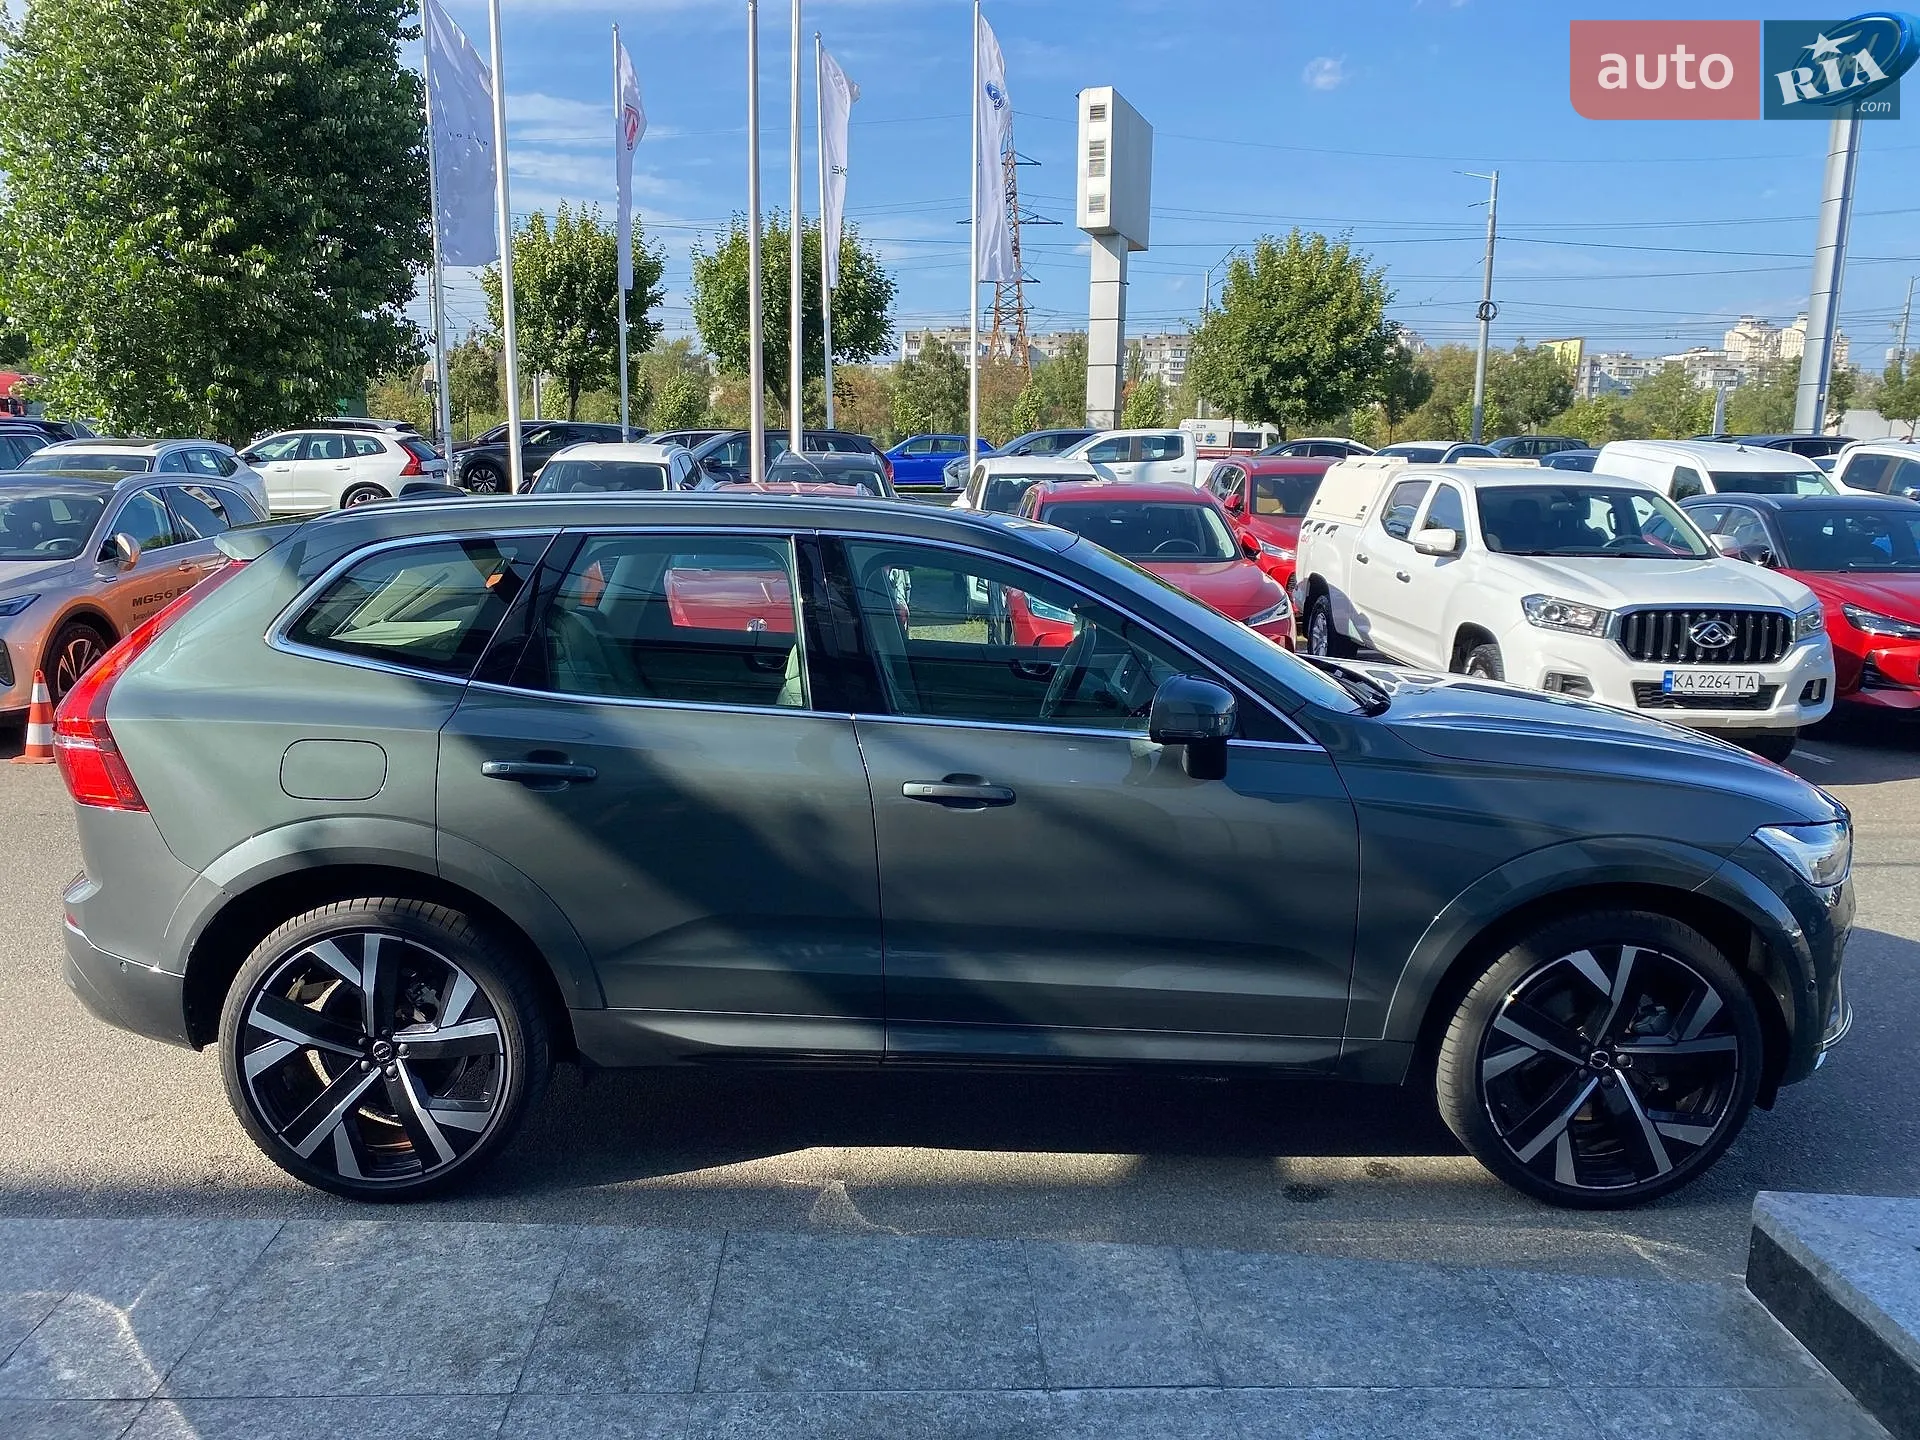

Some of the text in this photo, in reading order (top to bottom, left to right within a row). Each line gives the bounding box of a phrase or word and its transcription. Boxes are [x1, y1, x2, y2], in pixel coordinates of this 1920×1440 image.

[132, 589, 173, 608] MGS6
[1673, 673, 1756, 690] KA 2264 TA
